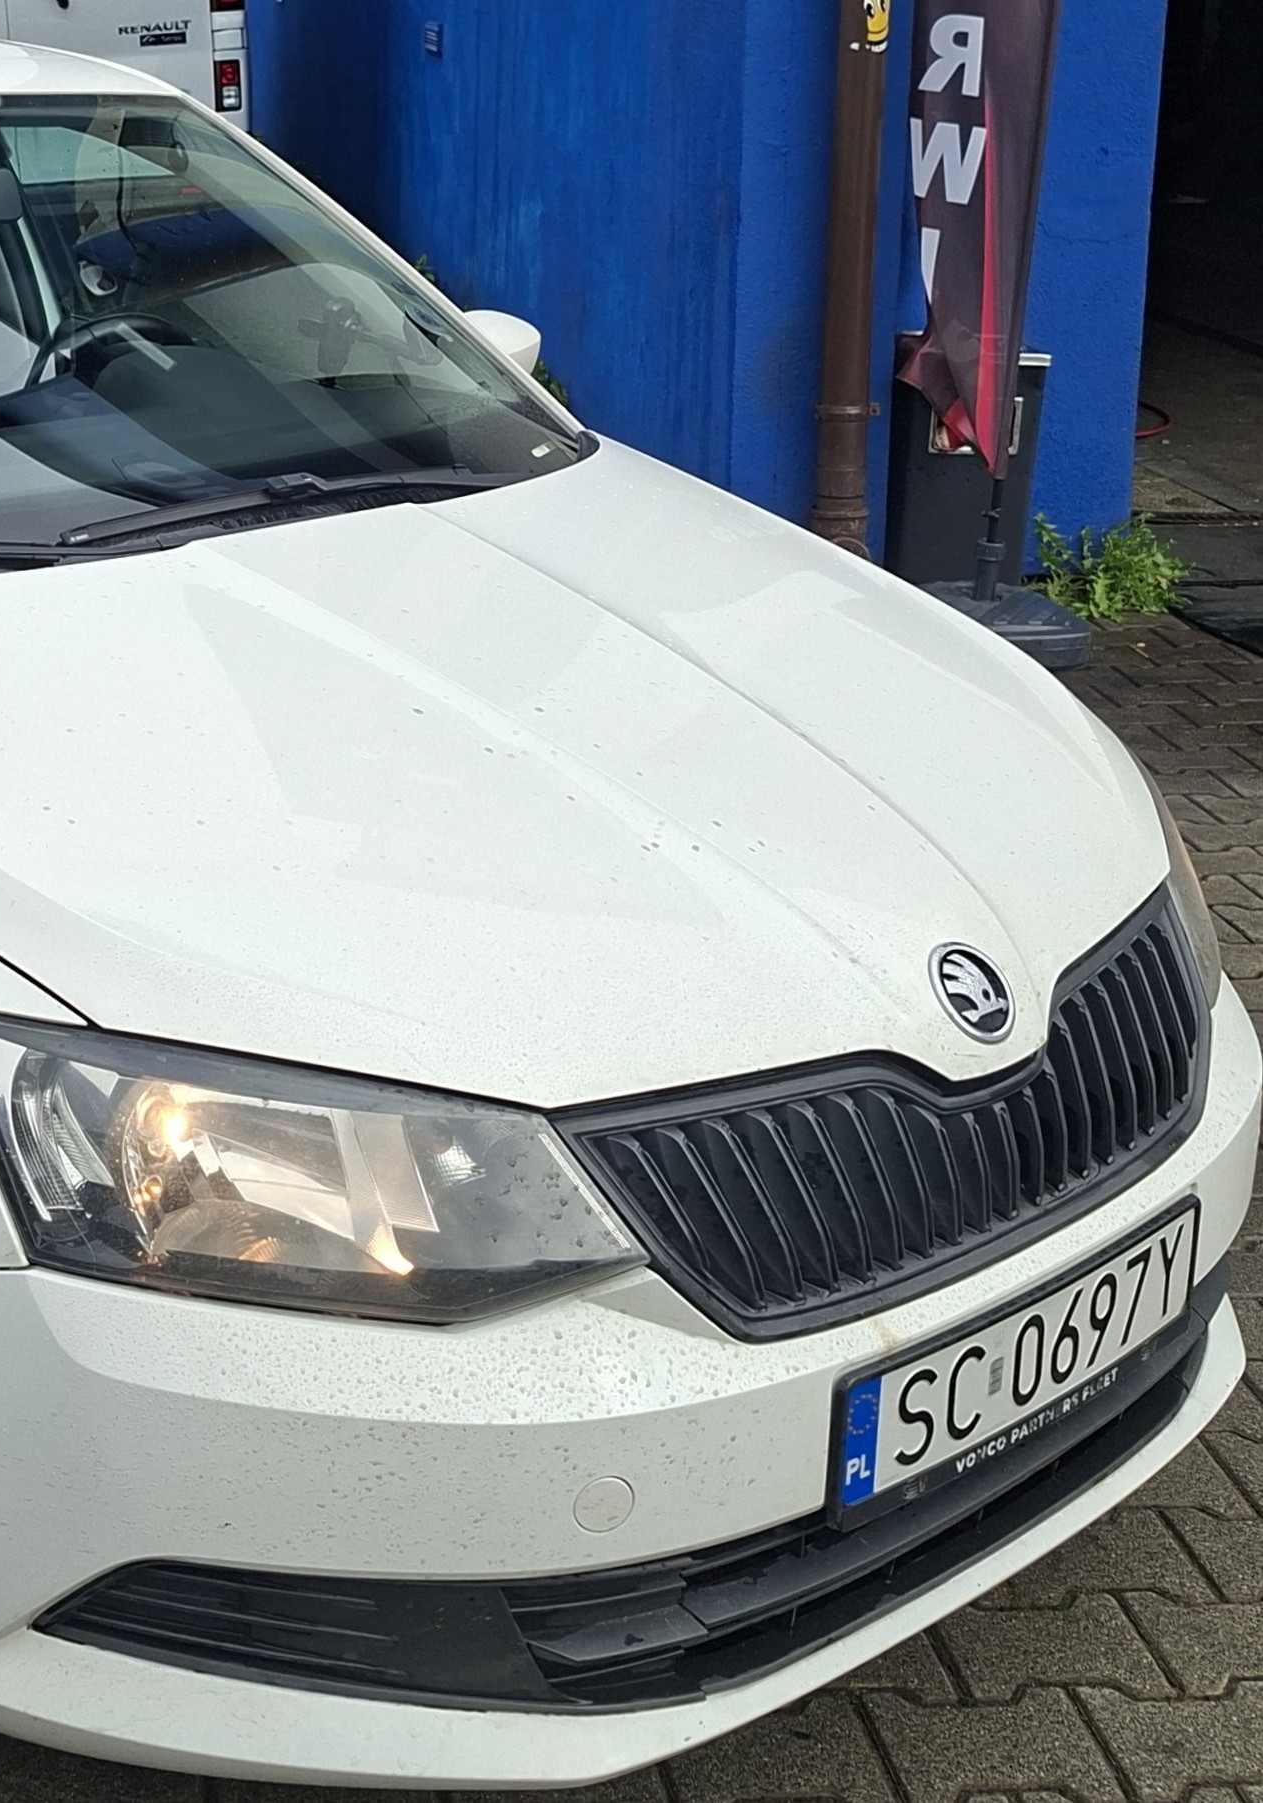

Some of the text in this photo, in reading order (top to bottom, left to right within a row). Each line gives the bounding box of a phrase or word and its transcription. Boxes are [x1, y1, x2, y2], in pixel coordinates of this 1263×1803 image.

[118, 20, 192, 36] RENAULT
[894, 1222, 1185, 1466] SC 0697Y
[1010, 1394, 1079, 1445] PARTNRS
[845, 1453, 871, 1486] PL
